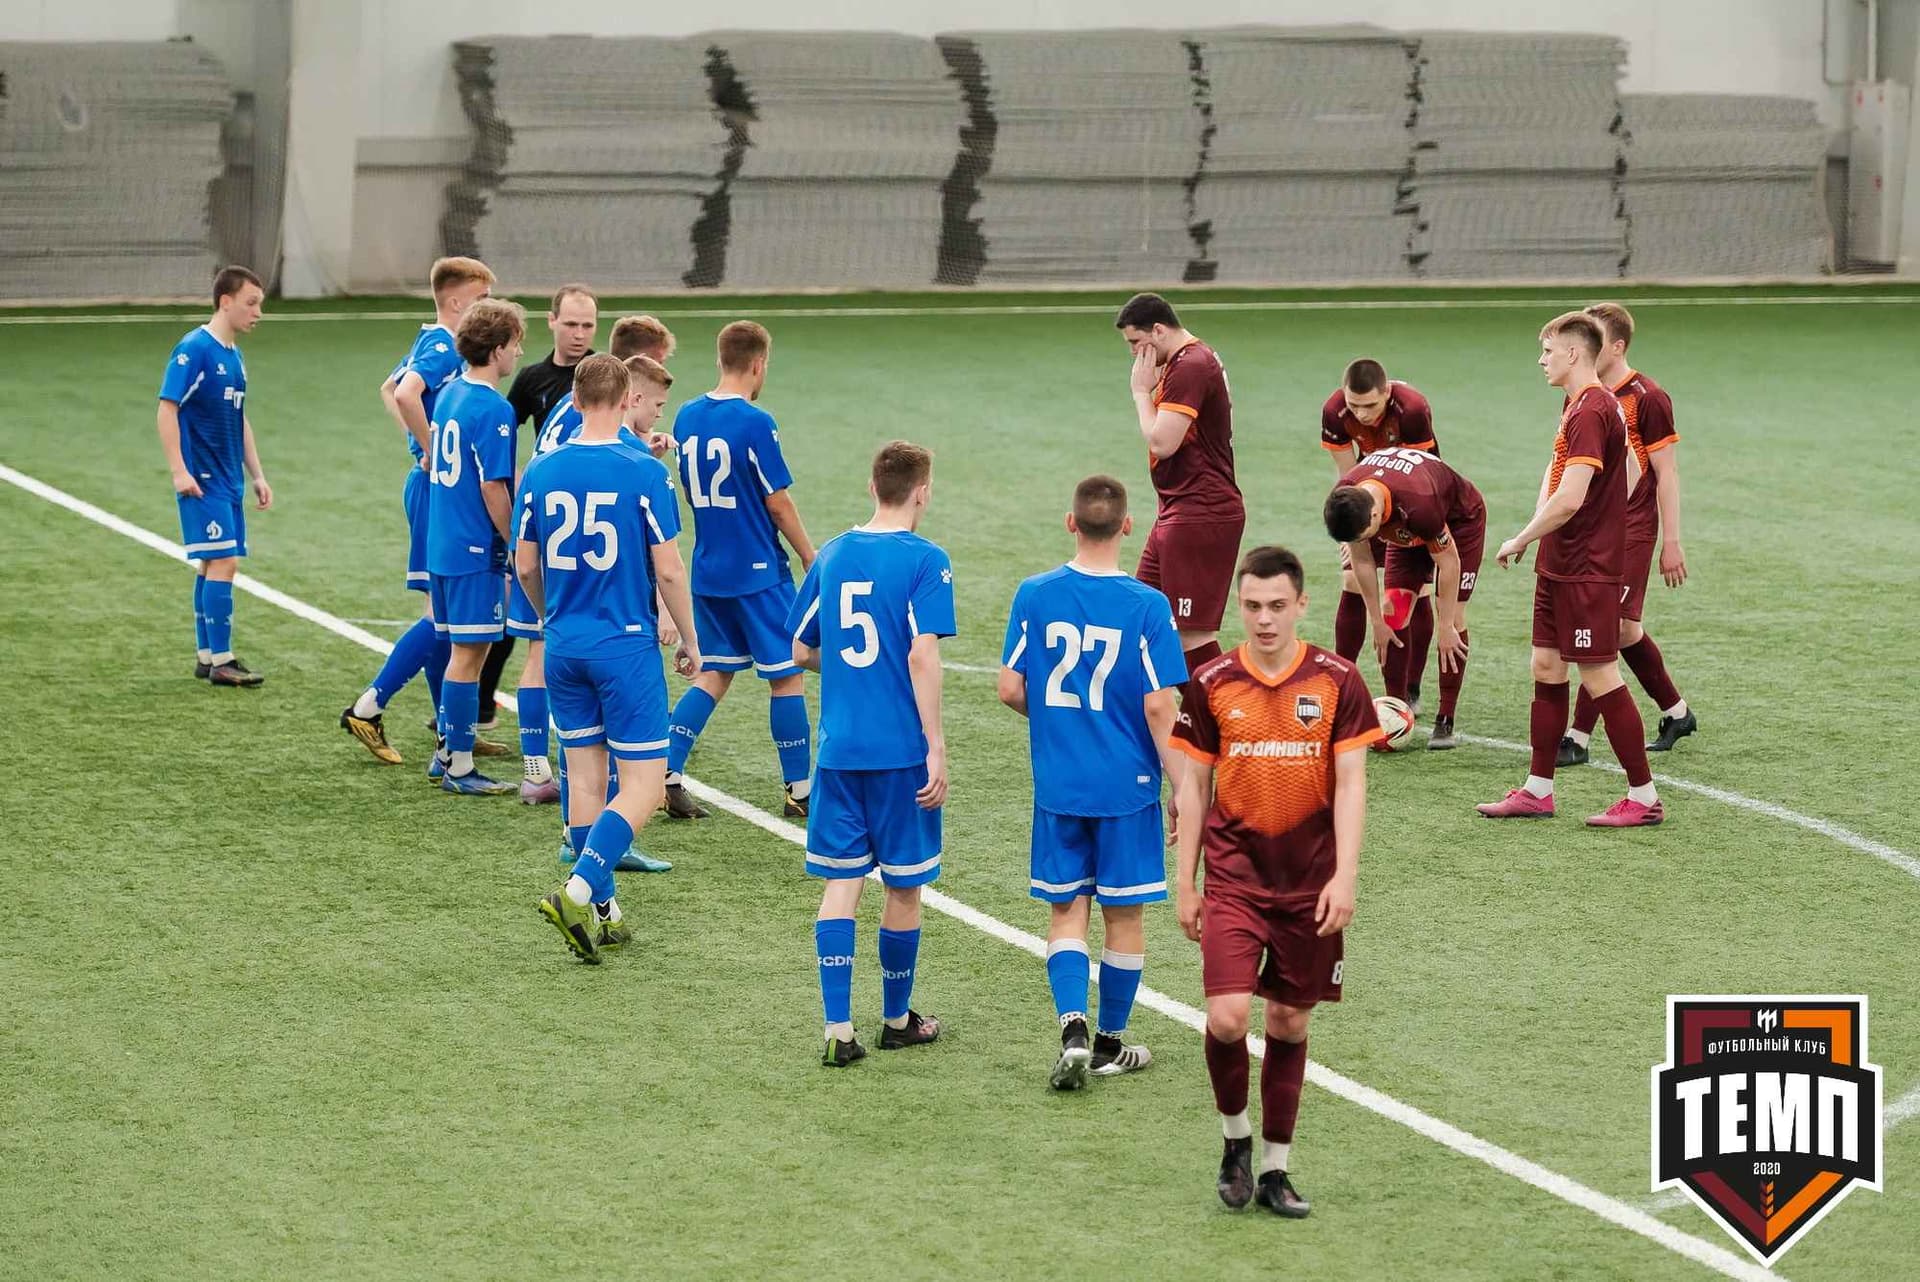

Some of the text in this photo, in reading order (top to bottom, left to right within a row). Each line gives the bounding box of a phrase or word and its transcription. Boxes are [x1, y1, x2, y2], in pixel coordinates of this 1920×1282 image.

[430, 419, 462, 488] 19
[682, 435, 737, 510] 12
[544, 491, 619, 572] 25
[840, 581, 880, 669] 5
[1178, 598, 1192, 617] 13
[1575, 629, 1592, 648] 25
[1045, 621, 1122, 712] 27
[776, 738, 806, 749] CDM
[1331, 960, 1344, 985] 8
